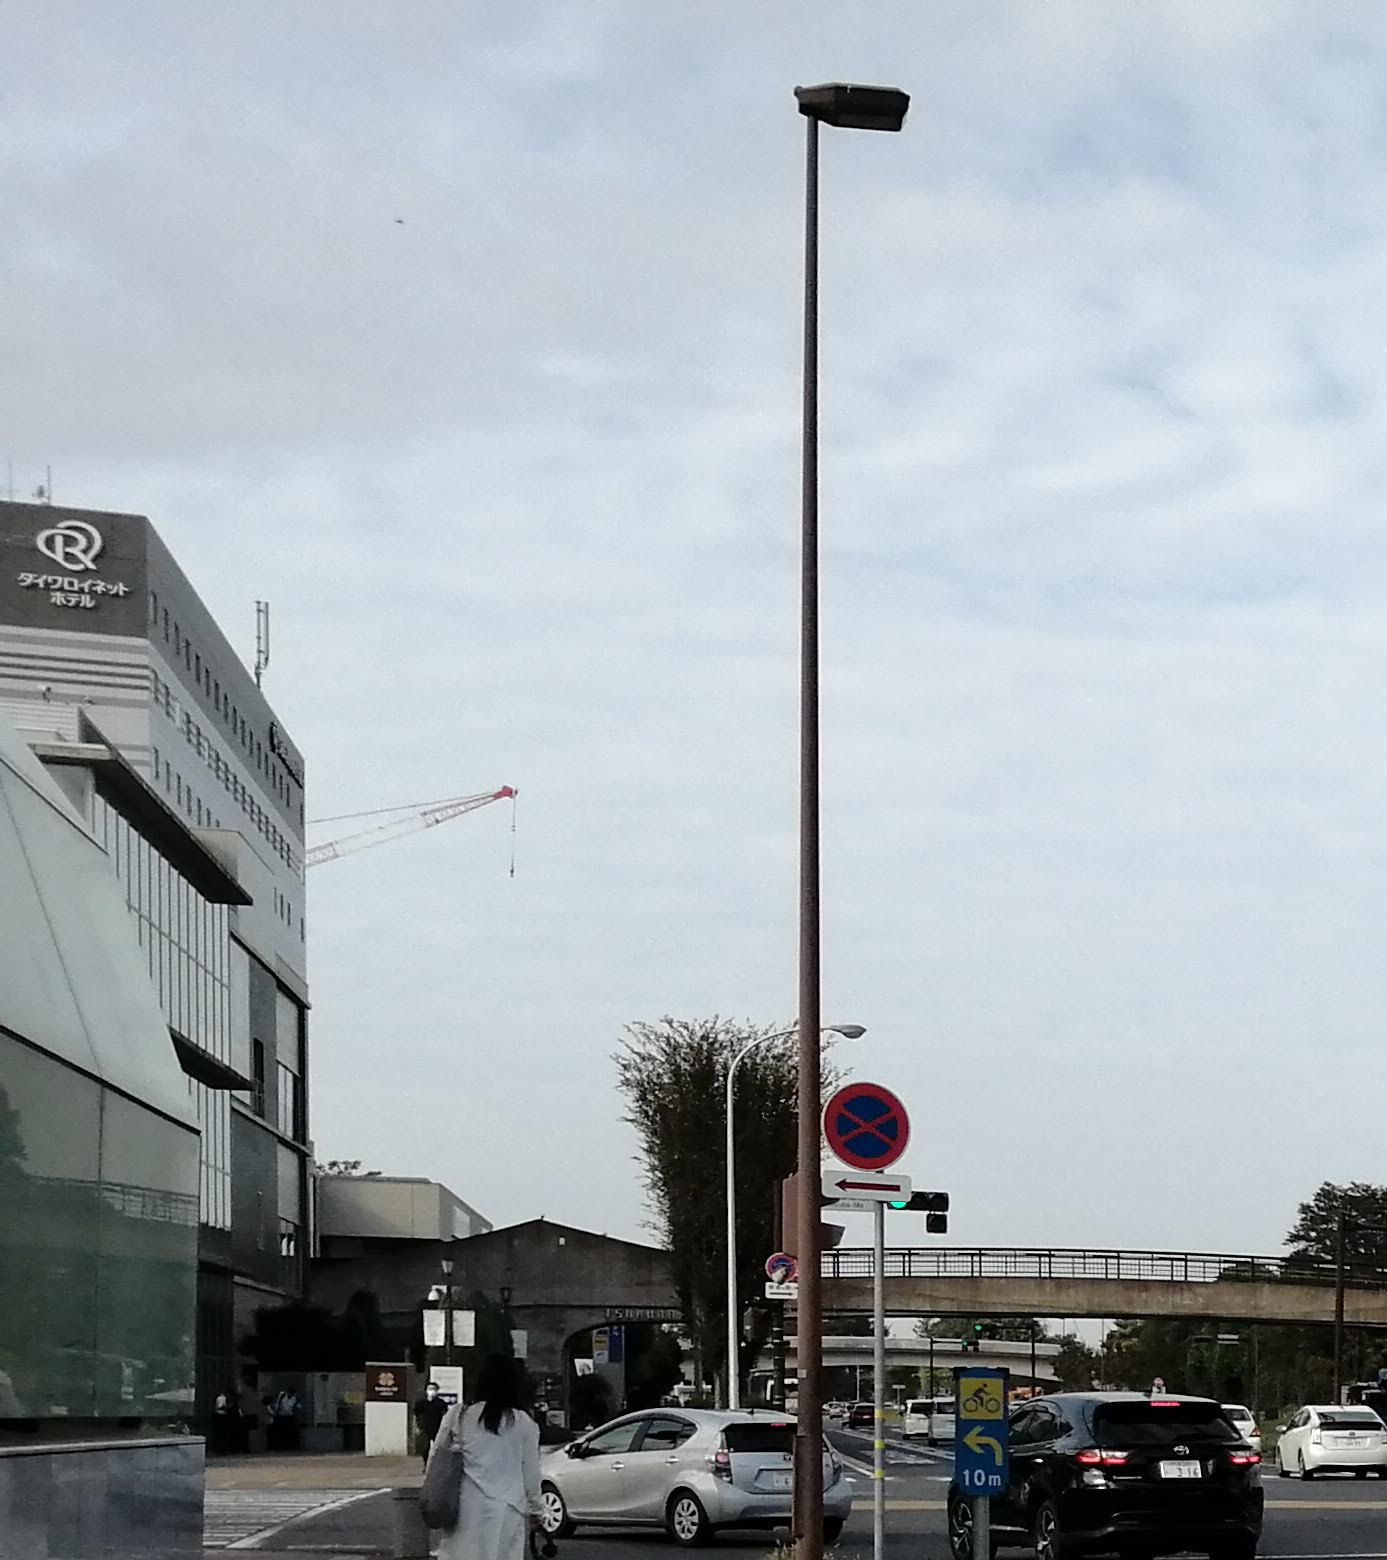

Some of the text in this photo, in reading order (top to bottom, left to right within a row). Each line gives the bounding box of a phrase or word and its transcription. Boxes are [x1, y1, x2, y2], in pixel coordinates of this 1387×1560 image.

[17, 572, 129, 596] ダイワロイネット
[50, 592, 96, 609] ホテル
[962, 1468, 1002, 1487] 10m
